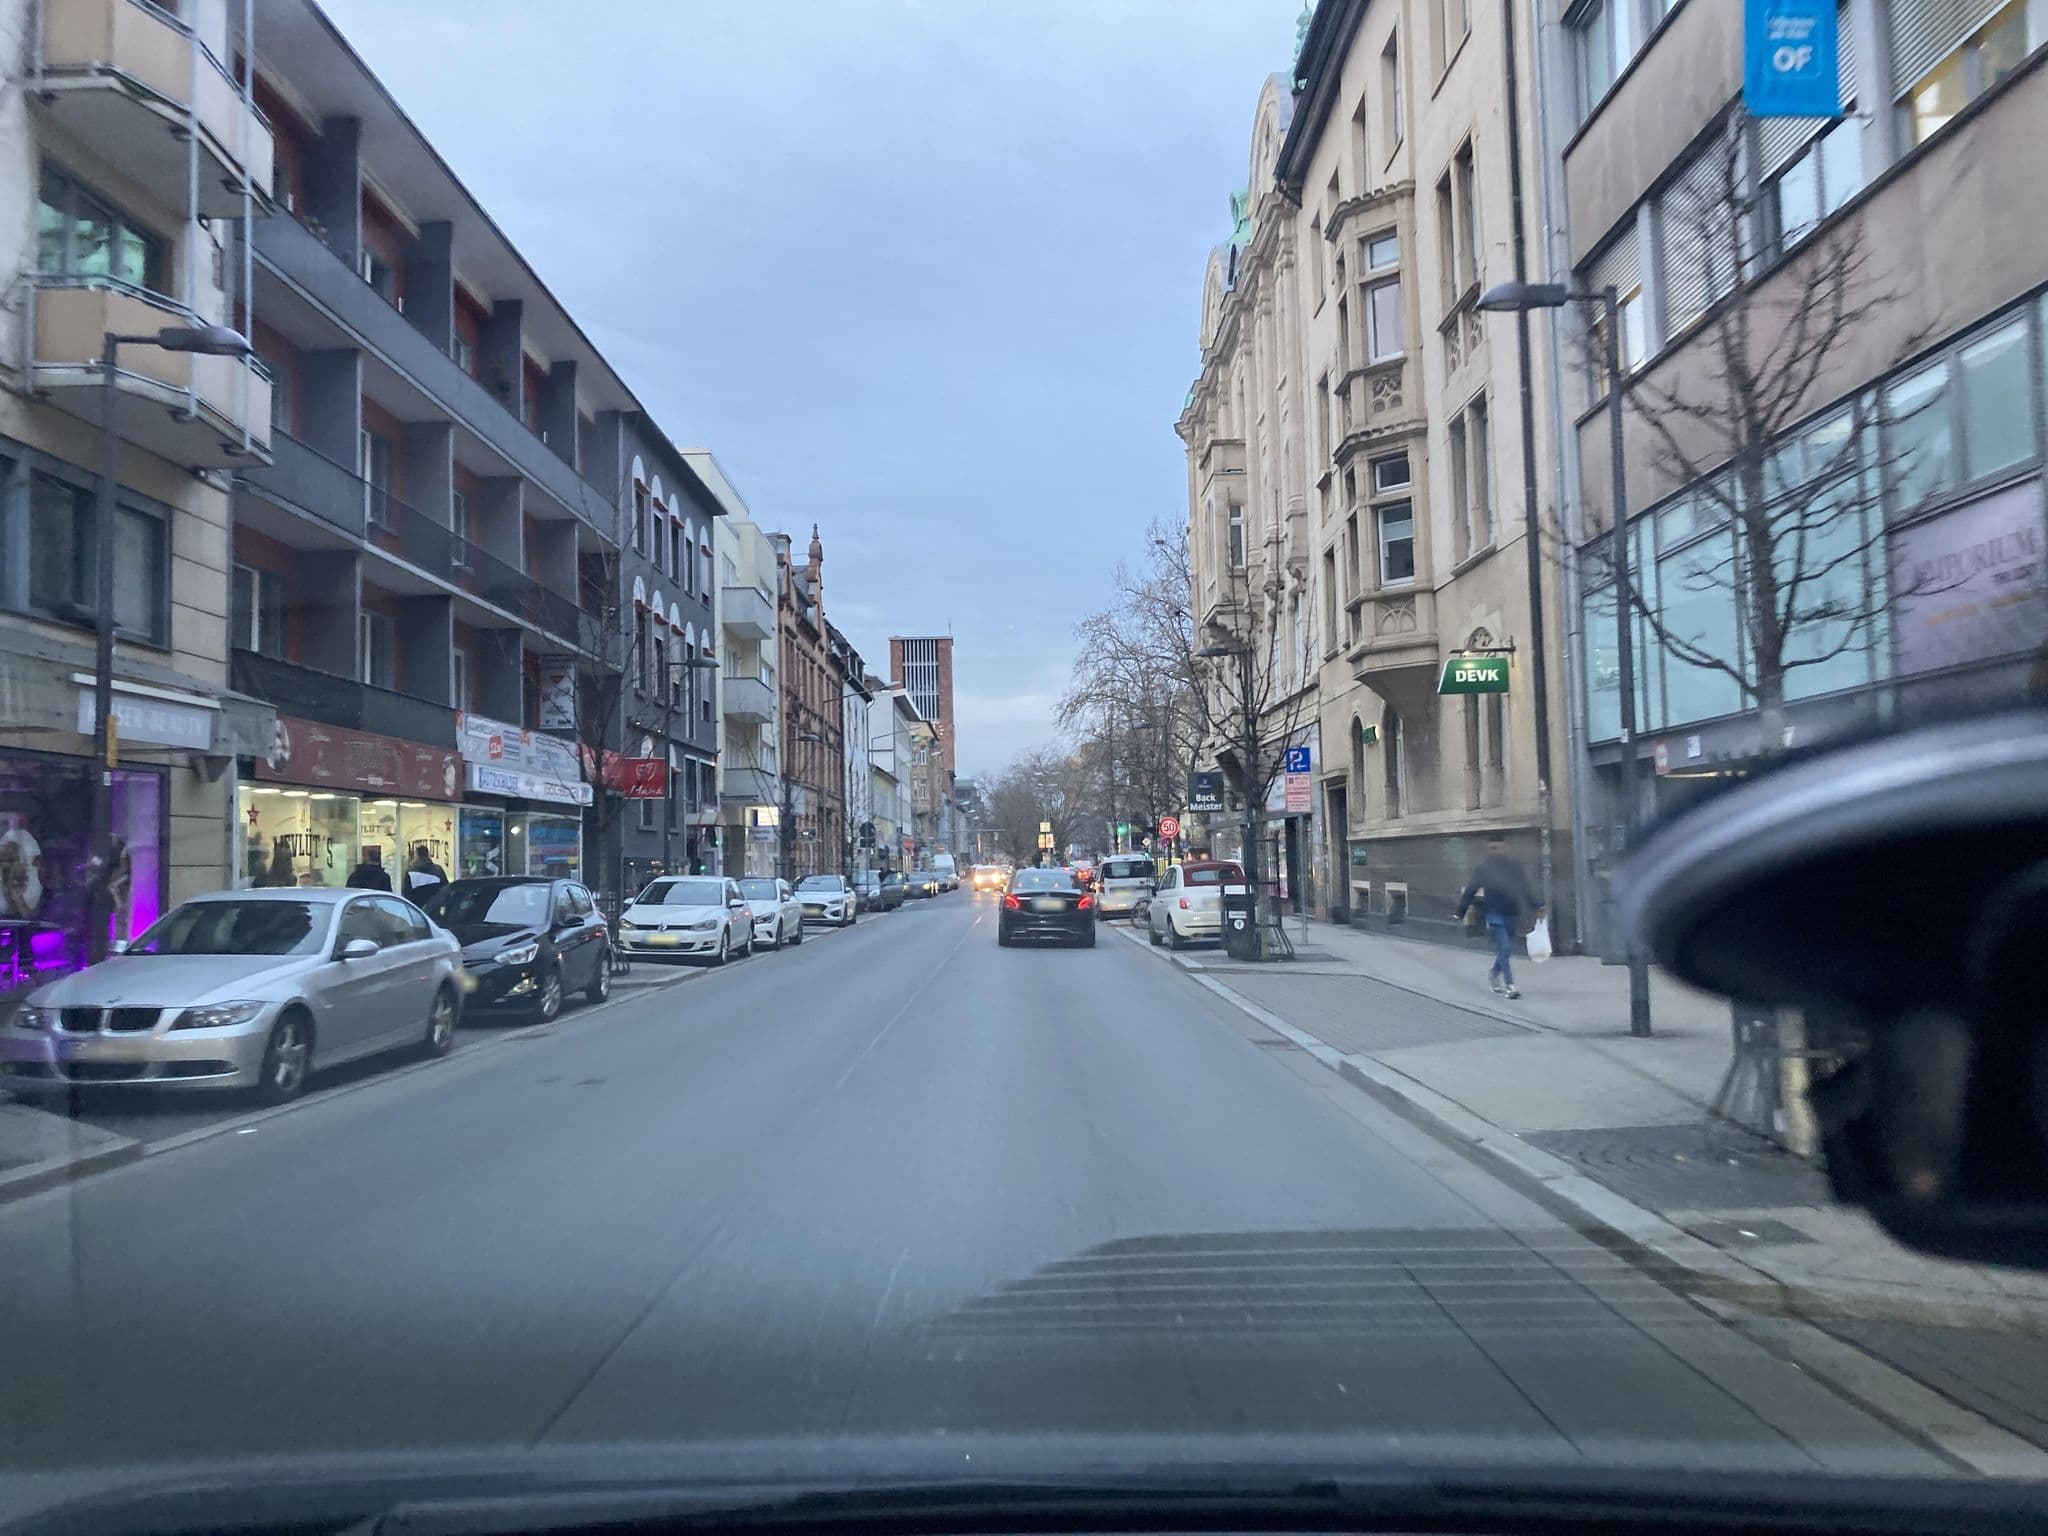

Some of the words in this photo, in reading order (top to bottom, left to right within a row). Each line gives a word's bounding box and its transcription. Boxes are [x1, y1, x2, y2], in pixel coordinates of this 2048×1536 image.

[1773, 45, 1813, 72] OF
[1455, 669, 1499, 682] DEVK
[1196, 793, 1216, 802] Back
[1190, 802, 1222, 811] Meister
[1164, 822, 1175, 832] 50
